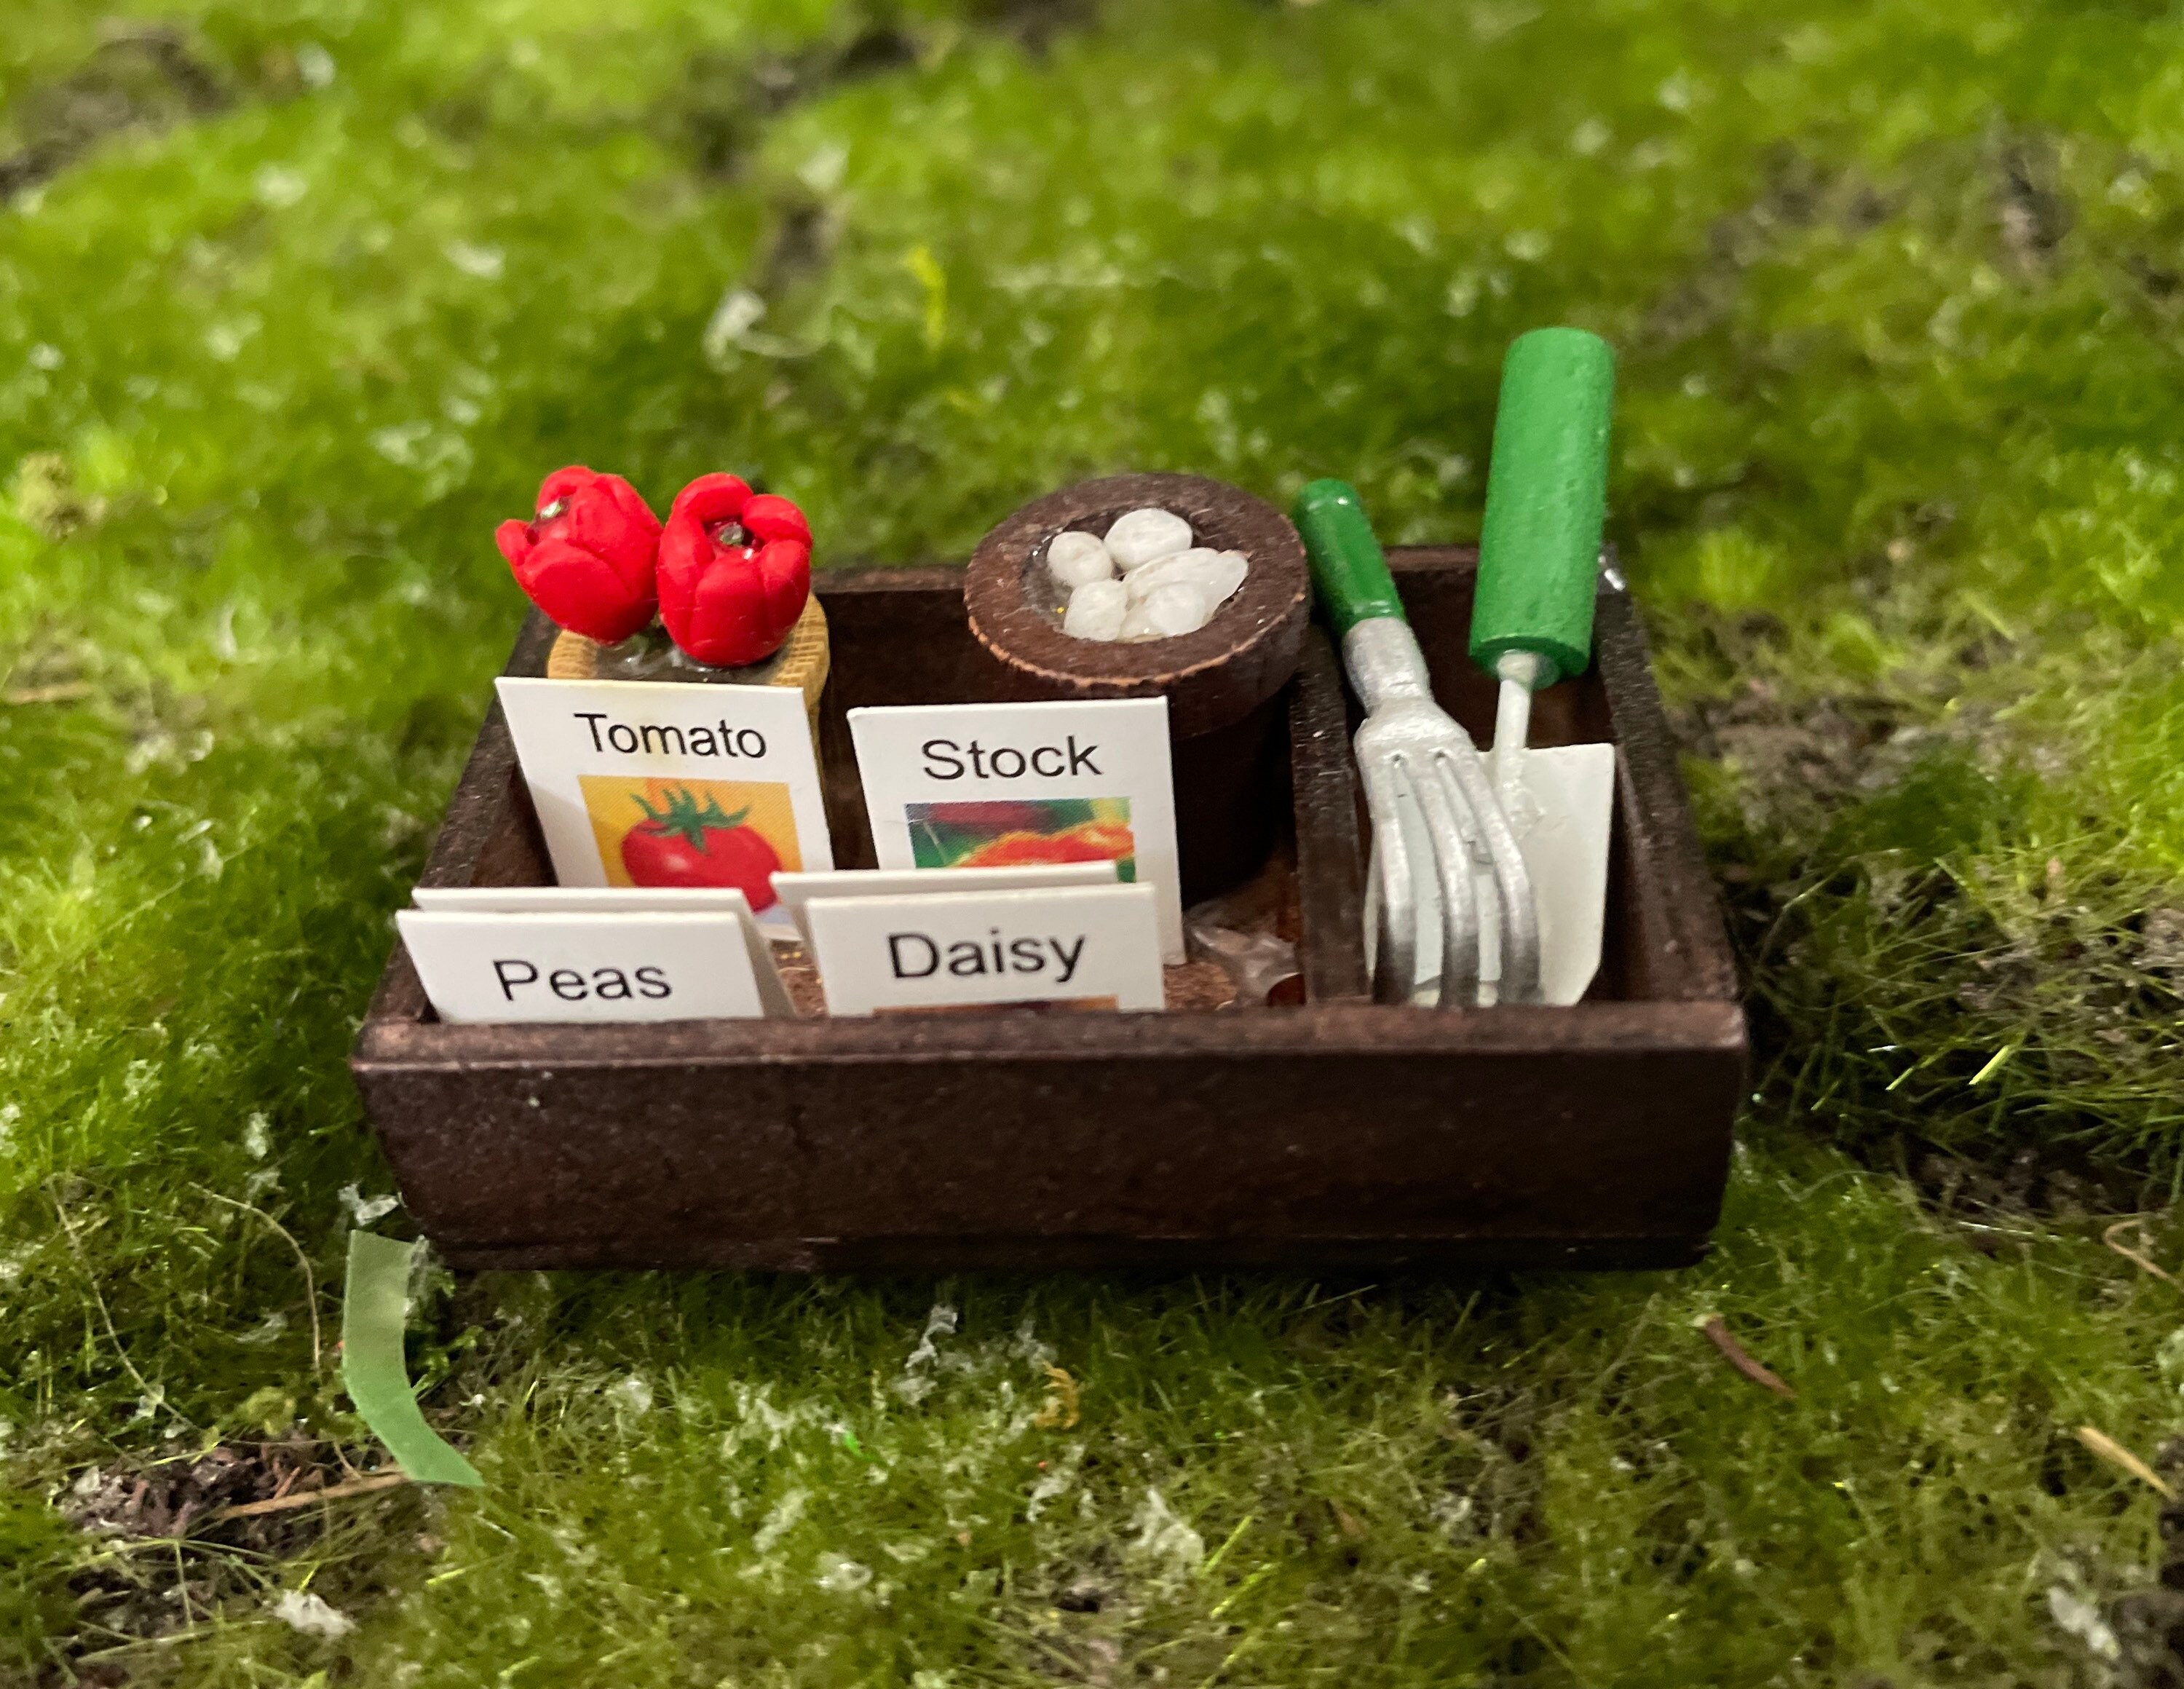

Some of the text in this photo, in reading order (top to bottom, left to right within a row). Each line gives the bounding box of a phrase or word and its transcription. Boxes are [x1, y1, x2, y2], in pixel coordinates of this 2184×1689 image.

[573, 712, 767, 759] Tomato
[922, 735, 1103, 780] Stock
[887, 928, 1086, 984] Daisy
[492, 960, 673, 1002] Peas
